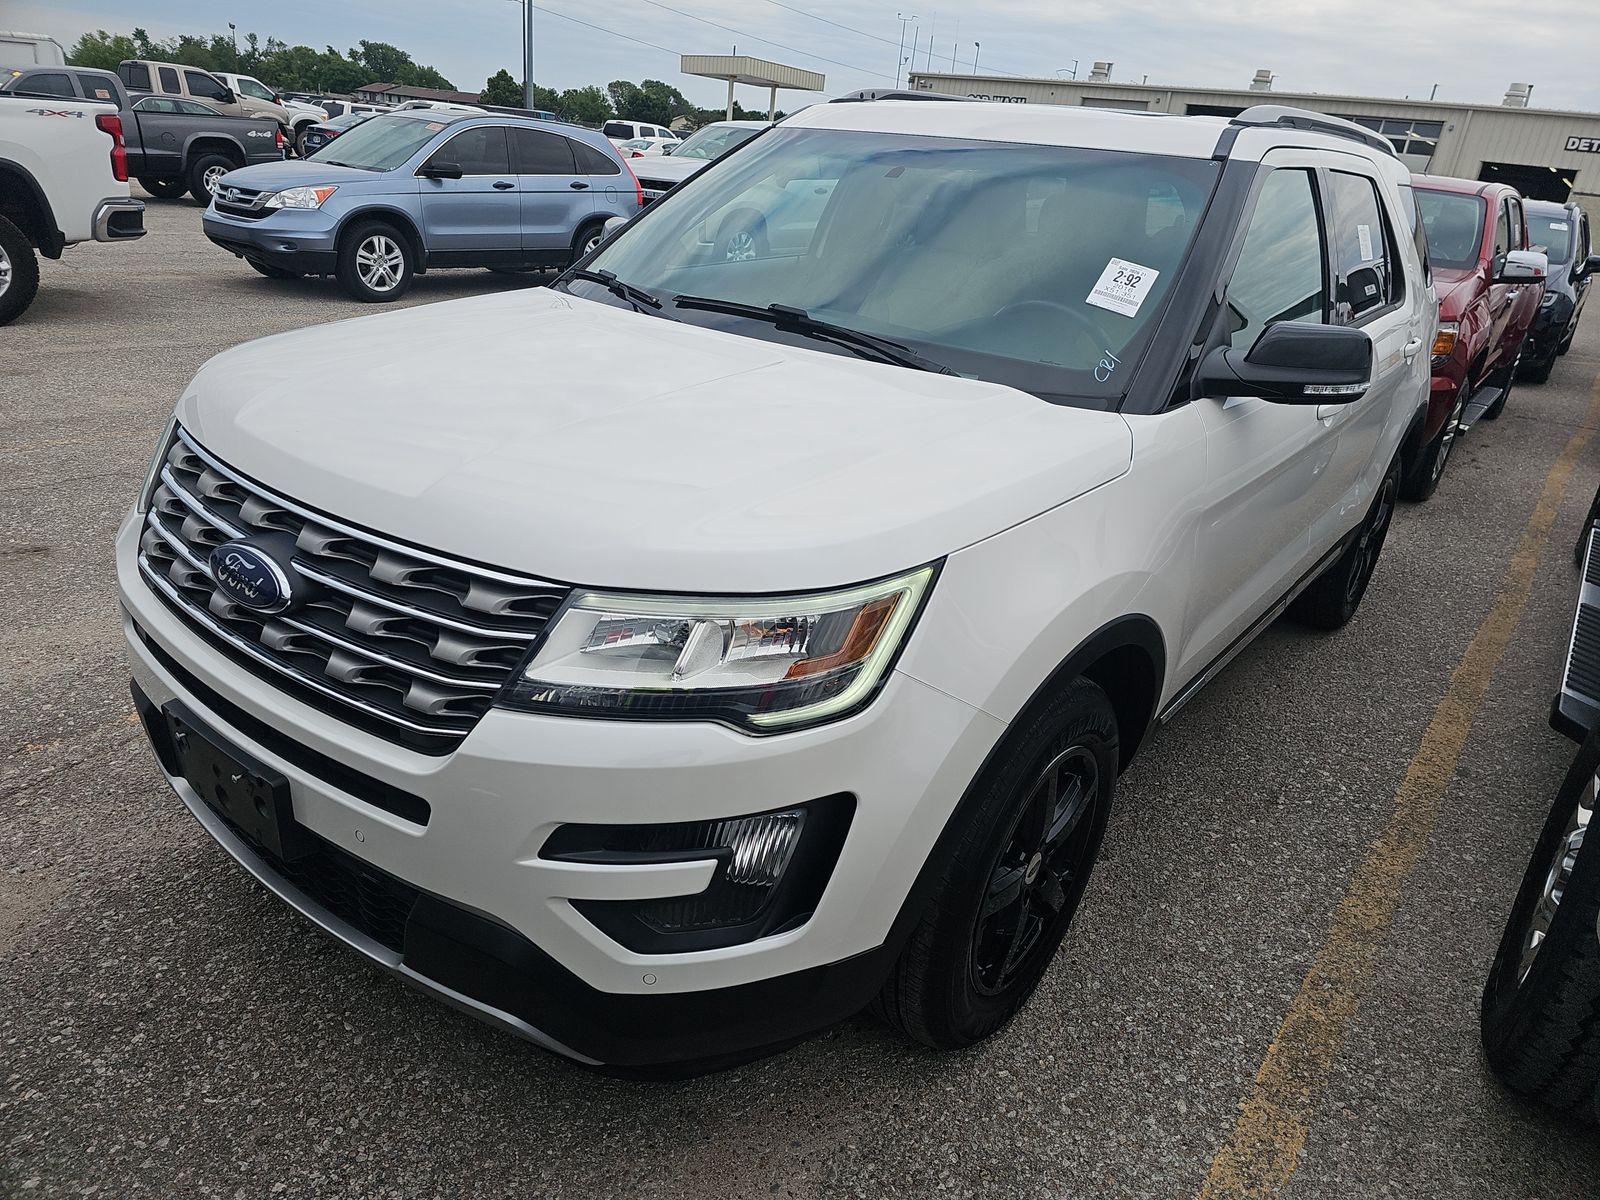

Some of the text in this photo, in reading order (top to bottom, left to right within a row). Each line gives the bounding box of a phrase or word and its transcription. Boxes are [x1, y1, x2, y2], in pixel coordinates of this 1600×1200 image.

[1564, 136, 1600, 154] DET
[1113, 270, 1142, 288] 2:92
[1113, 283, 1134, 293] 2016
[218, 552, 264, 599] Ford
